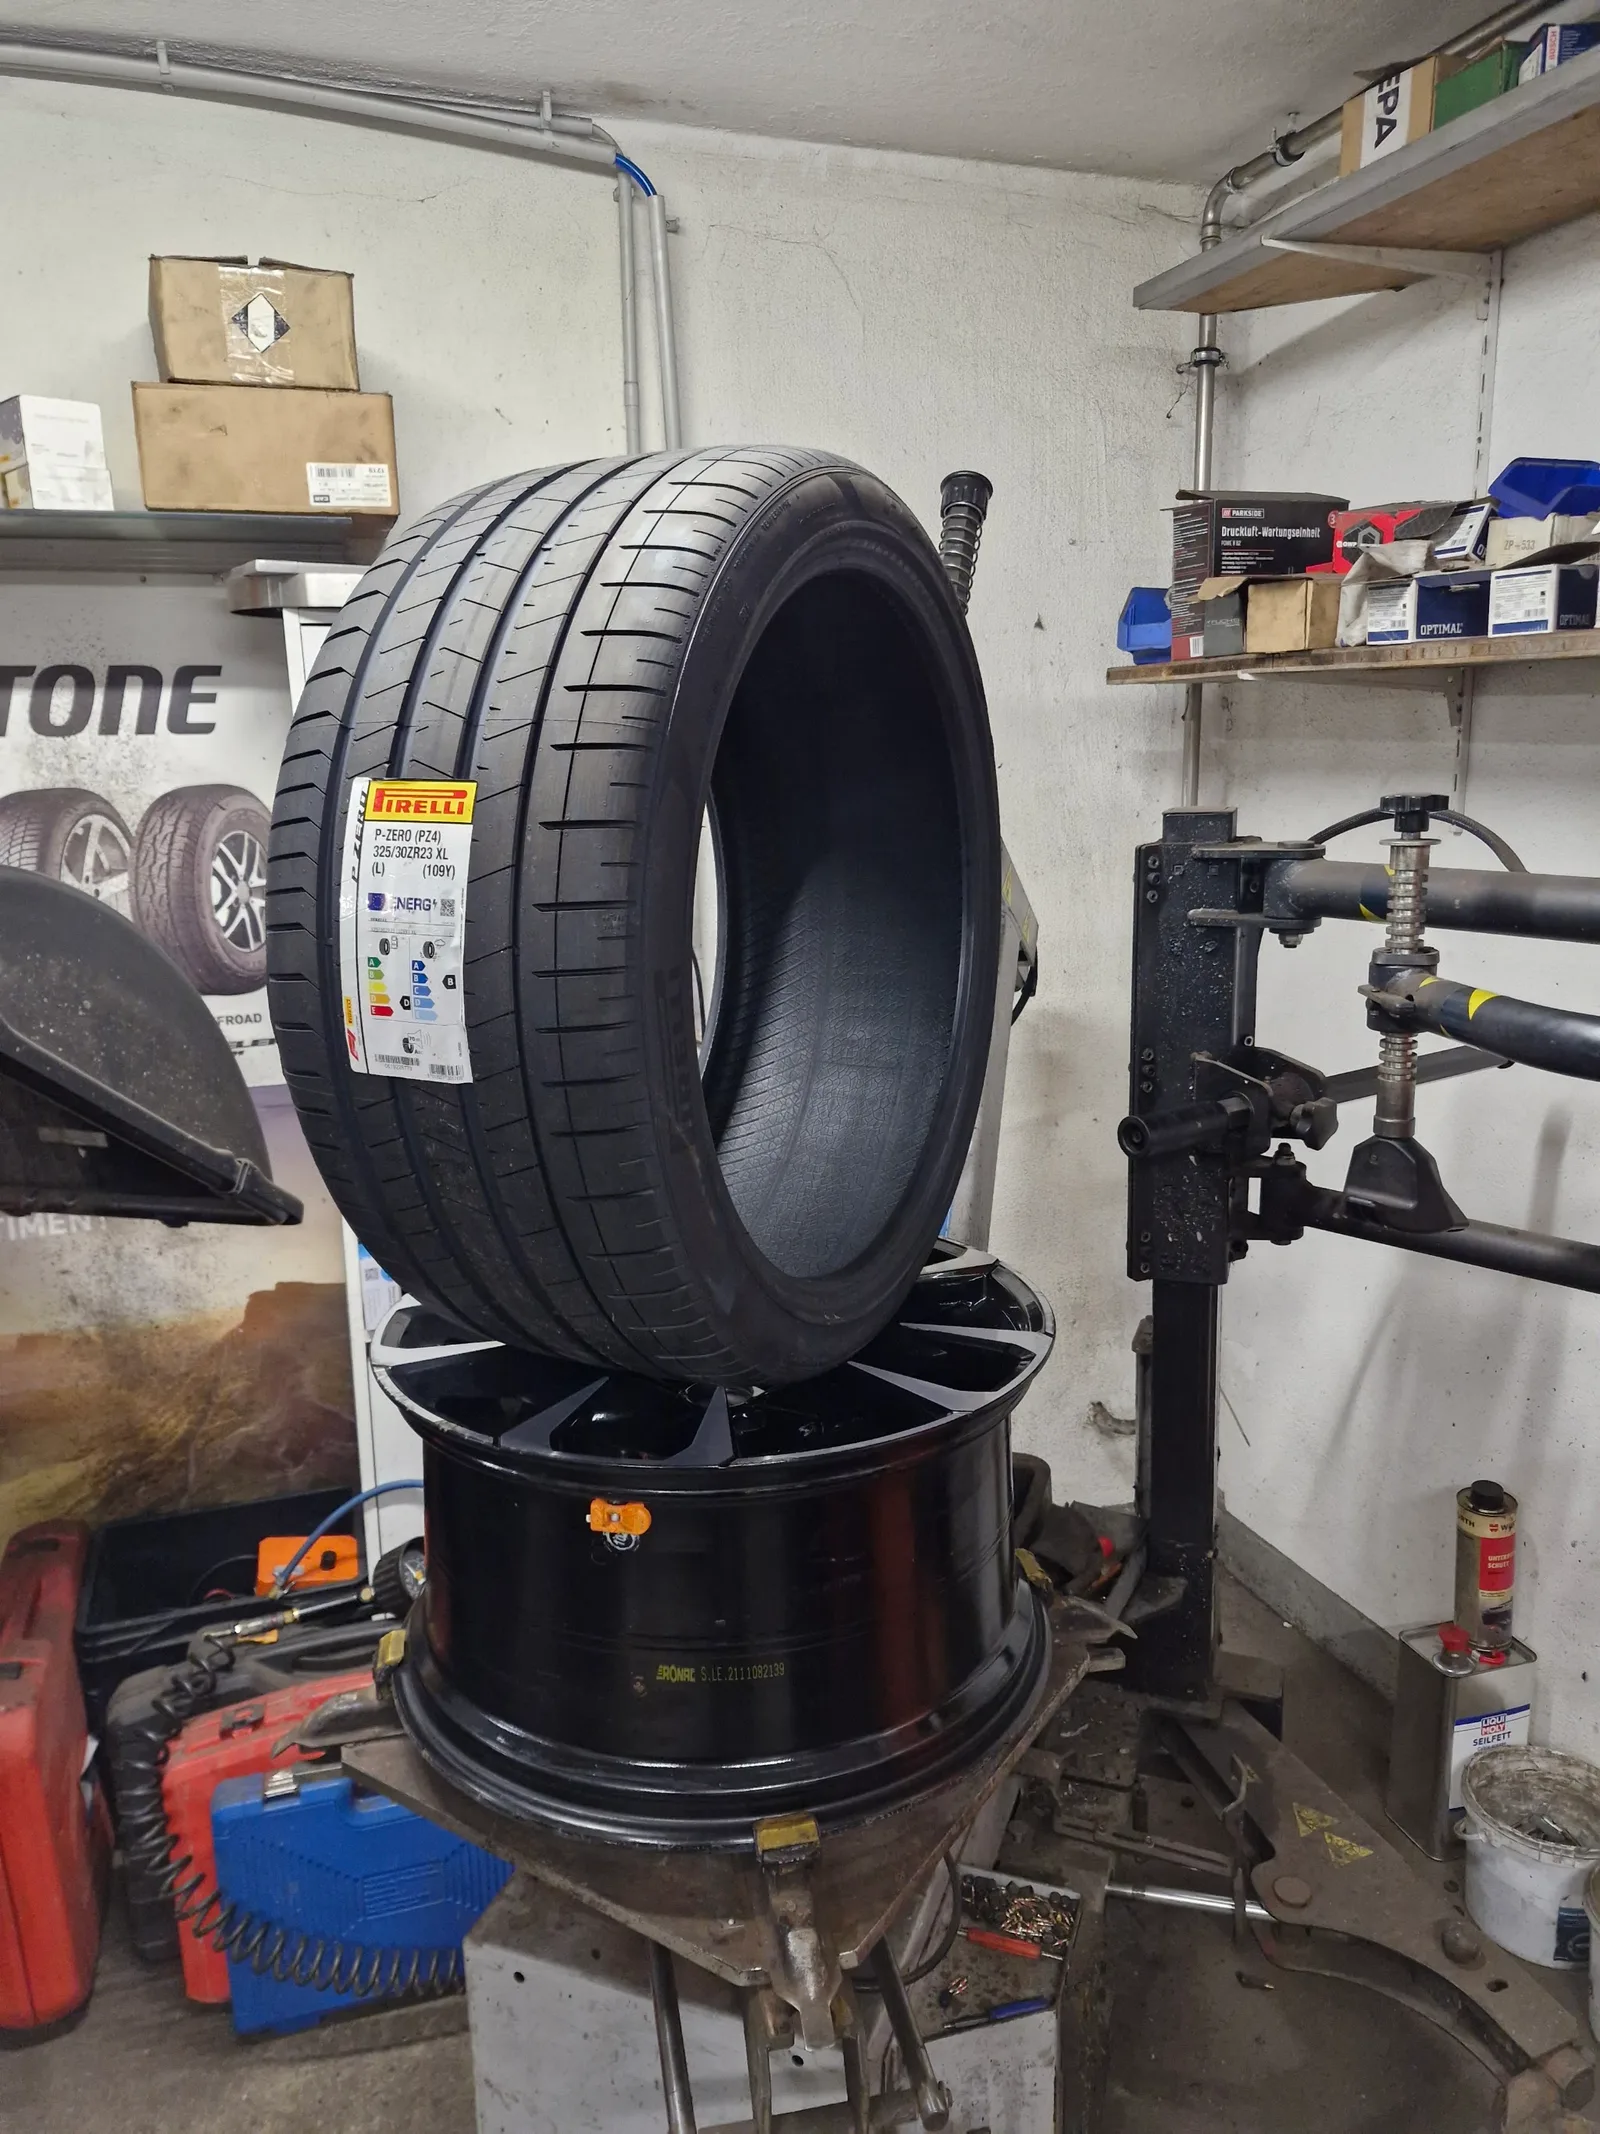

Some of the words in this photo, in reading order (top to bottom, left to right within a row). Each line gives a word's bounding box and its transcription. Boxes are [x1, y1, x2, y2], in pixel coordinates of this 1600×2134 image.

[1548, 31, 1557, 60] BOSCH
[1221, 526, 1320, 540] Druckluft-Wartungseinheit
[372, 787, 468, 815] PIRELLI
[374, 828, 412, 842] P-ZERO
[414, 829, 442, 846] (PZ4)
[373, 845, 433, 860] 325/30ZR23
[435, 847, 449, 860] XL
[371, 861, 385, 877] (L)
[422, 863, 456, 880] (109Y)
[391, 896, 432, 911] ENERG
[447, 977, 454, 987] B
[403, 999, 410, 1008] D
[662, 1664, 696, 1683] RONAL
[1482, 1716, 1506, 1727] LIQUI
[1482, 1724, 1506, 1735] MOLY
[1473, 1731, 1512, 1747] SEILFETT
